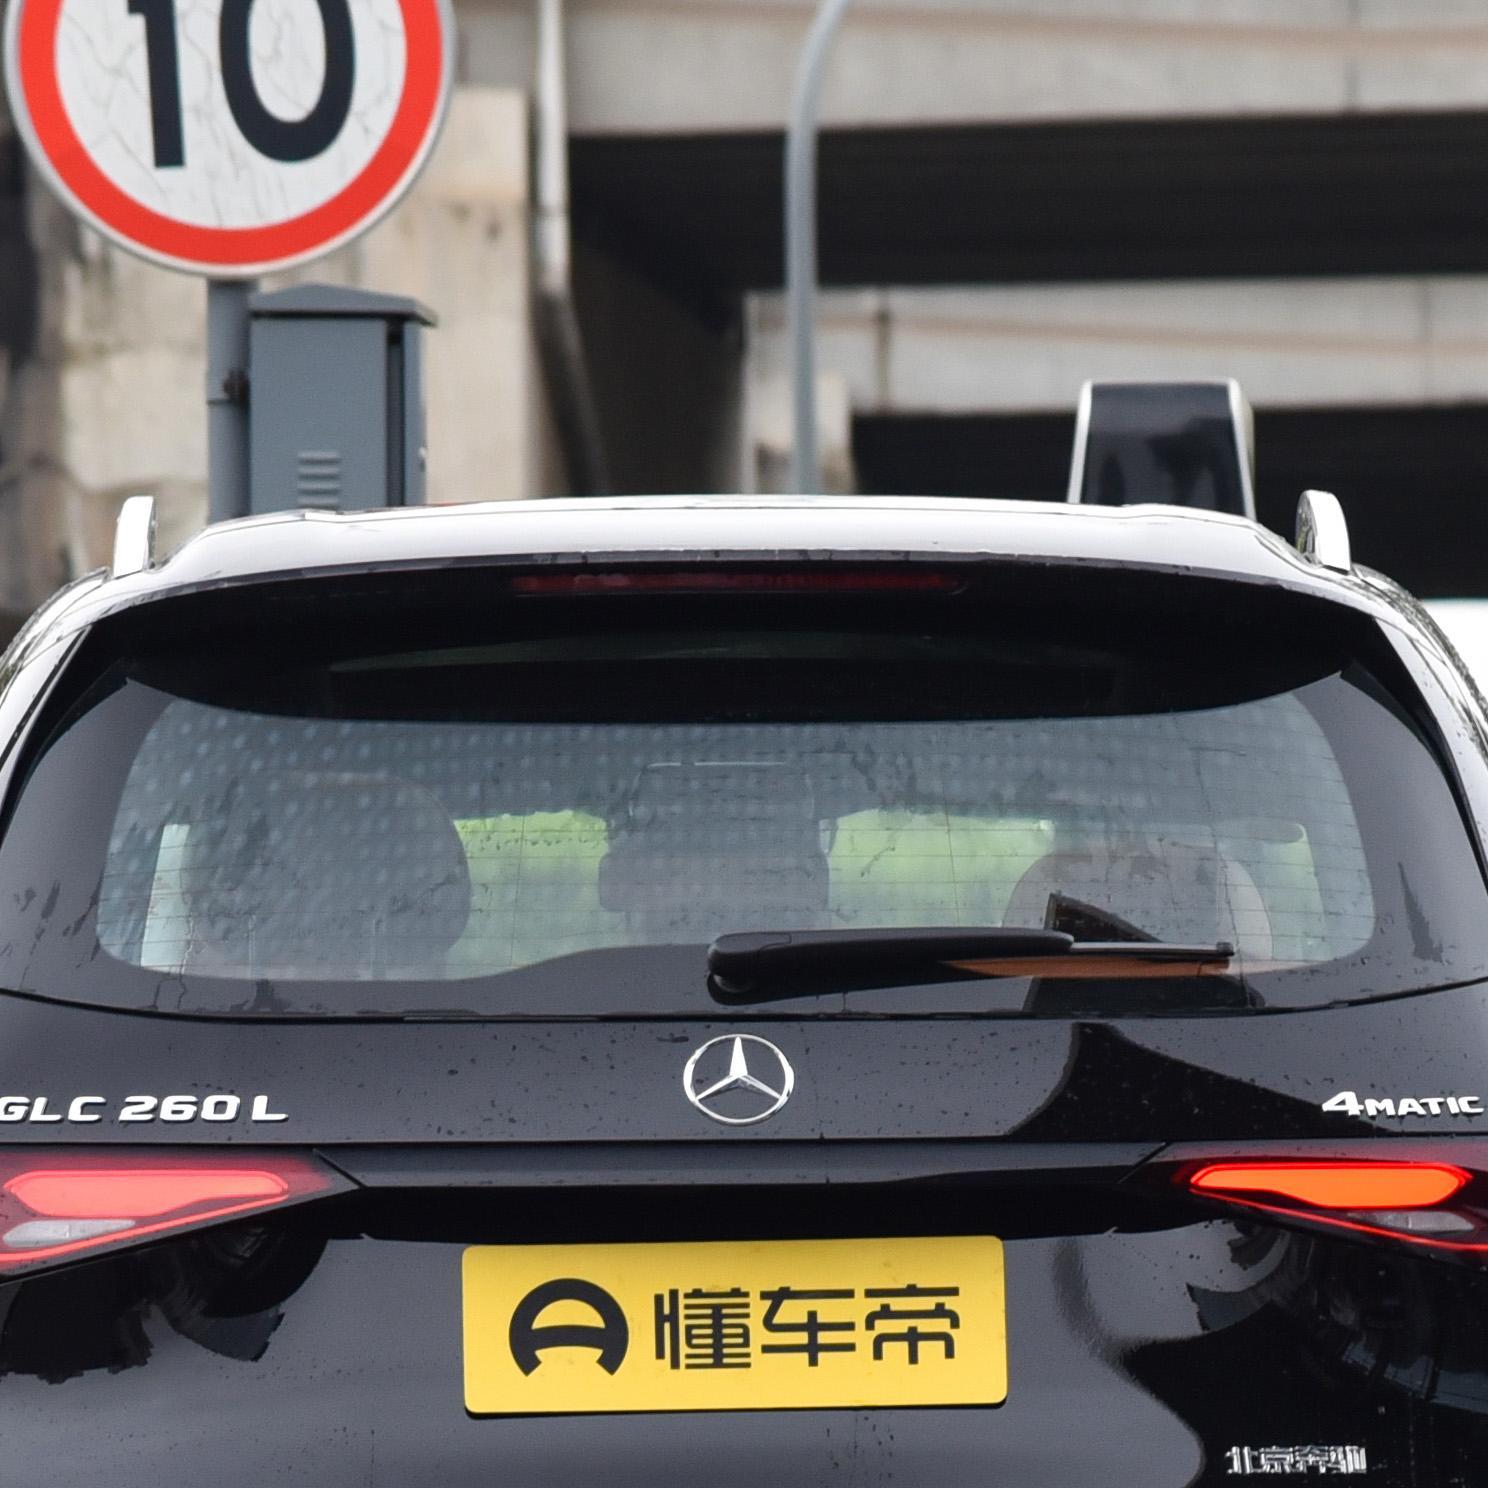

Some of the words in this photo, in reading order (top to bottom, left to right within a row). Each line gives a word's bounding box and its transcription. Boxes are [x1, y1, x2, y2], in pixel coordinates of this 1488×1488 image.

[127, 0, 356, 168] 10
[1321, 1090, 1485, 1117] 4MATIC
[654, 1283, 960, 1370] 懂车帝
[1224, 1445, 1367, 1474] 北京奔驰
